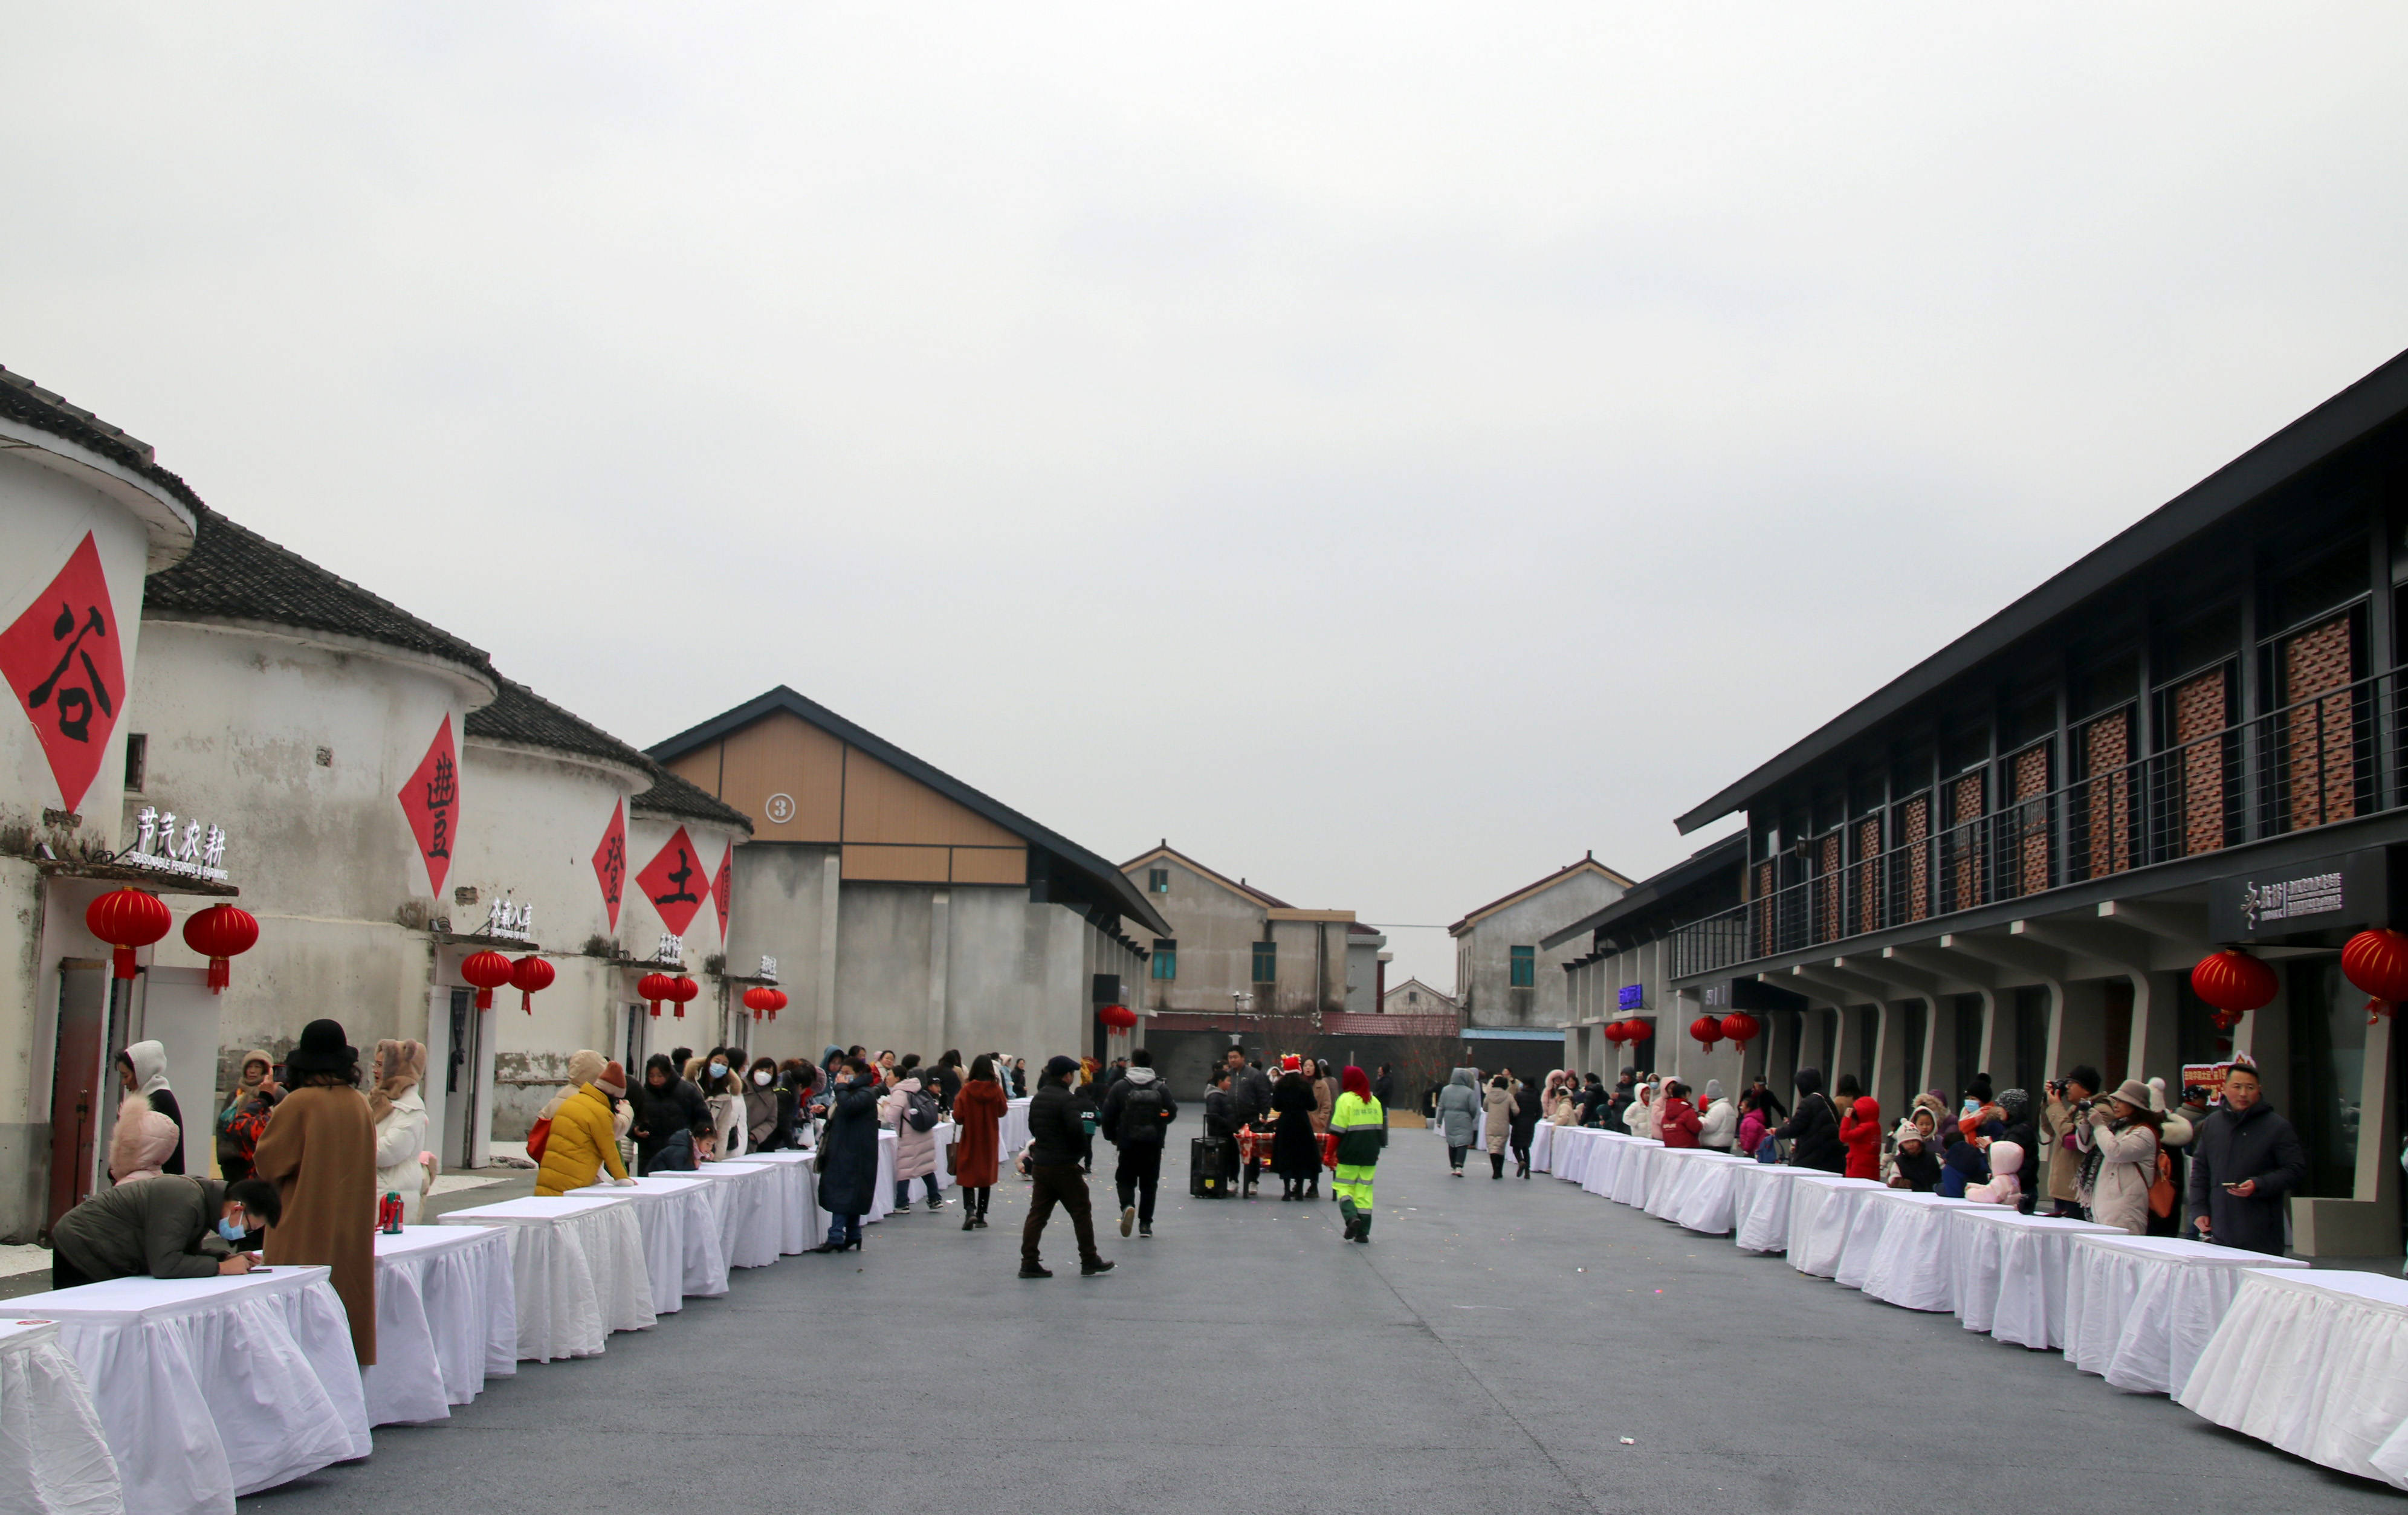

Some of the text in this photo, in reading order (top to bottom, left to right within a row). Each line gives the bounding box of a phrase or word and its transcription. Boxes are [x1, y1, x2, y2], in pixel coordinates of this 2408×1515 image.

[28, 601, 112, 743] 谷
[137, 806, 227, 867] 节气农耕
[775, 799, 786, 817] 3
[132, 851, 170, 870] SEASONABLE
[197, 865, 202, 876] &
[202, 866, 228, 880] FARMING
[654, 848, 698, 905] 土
